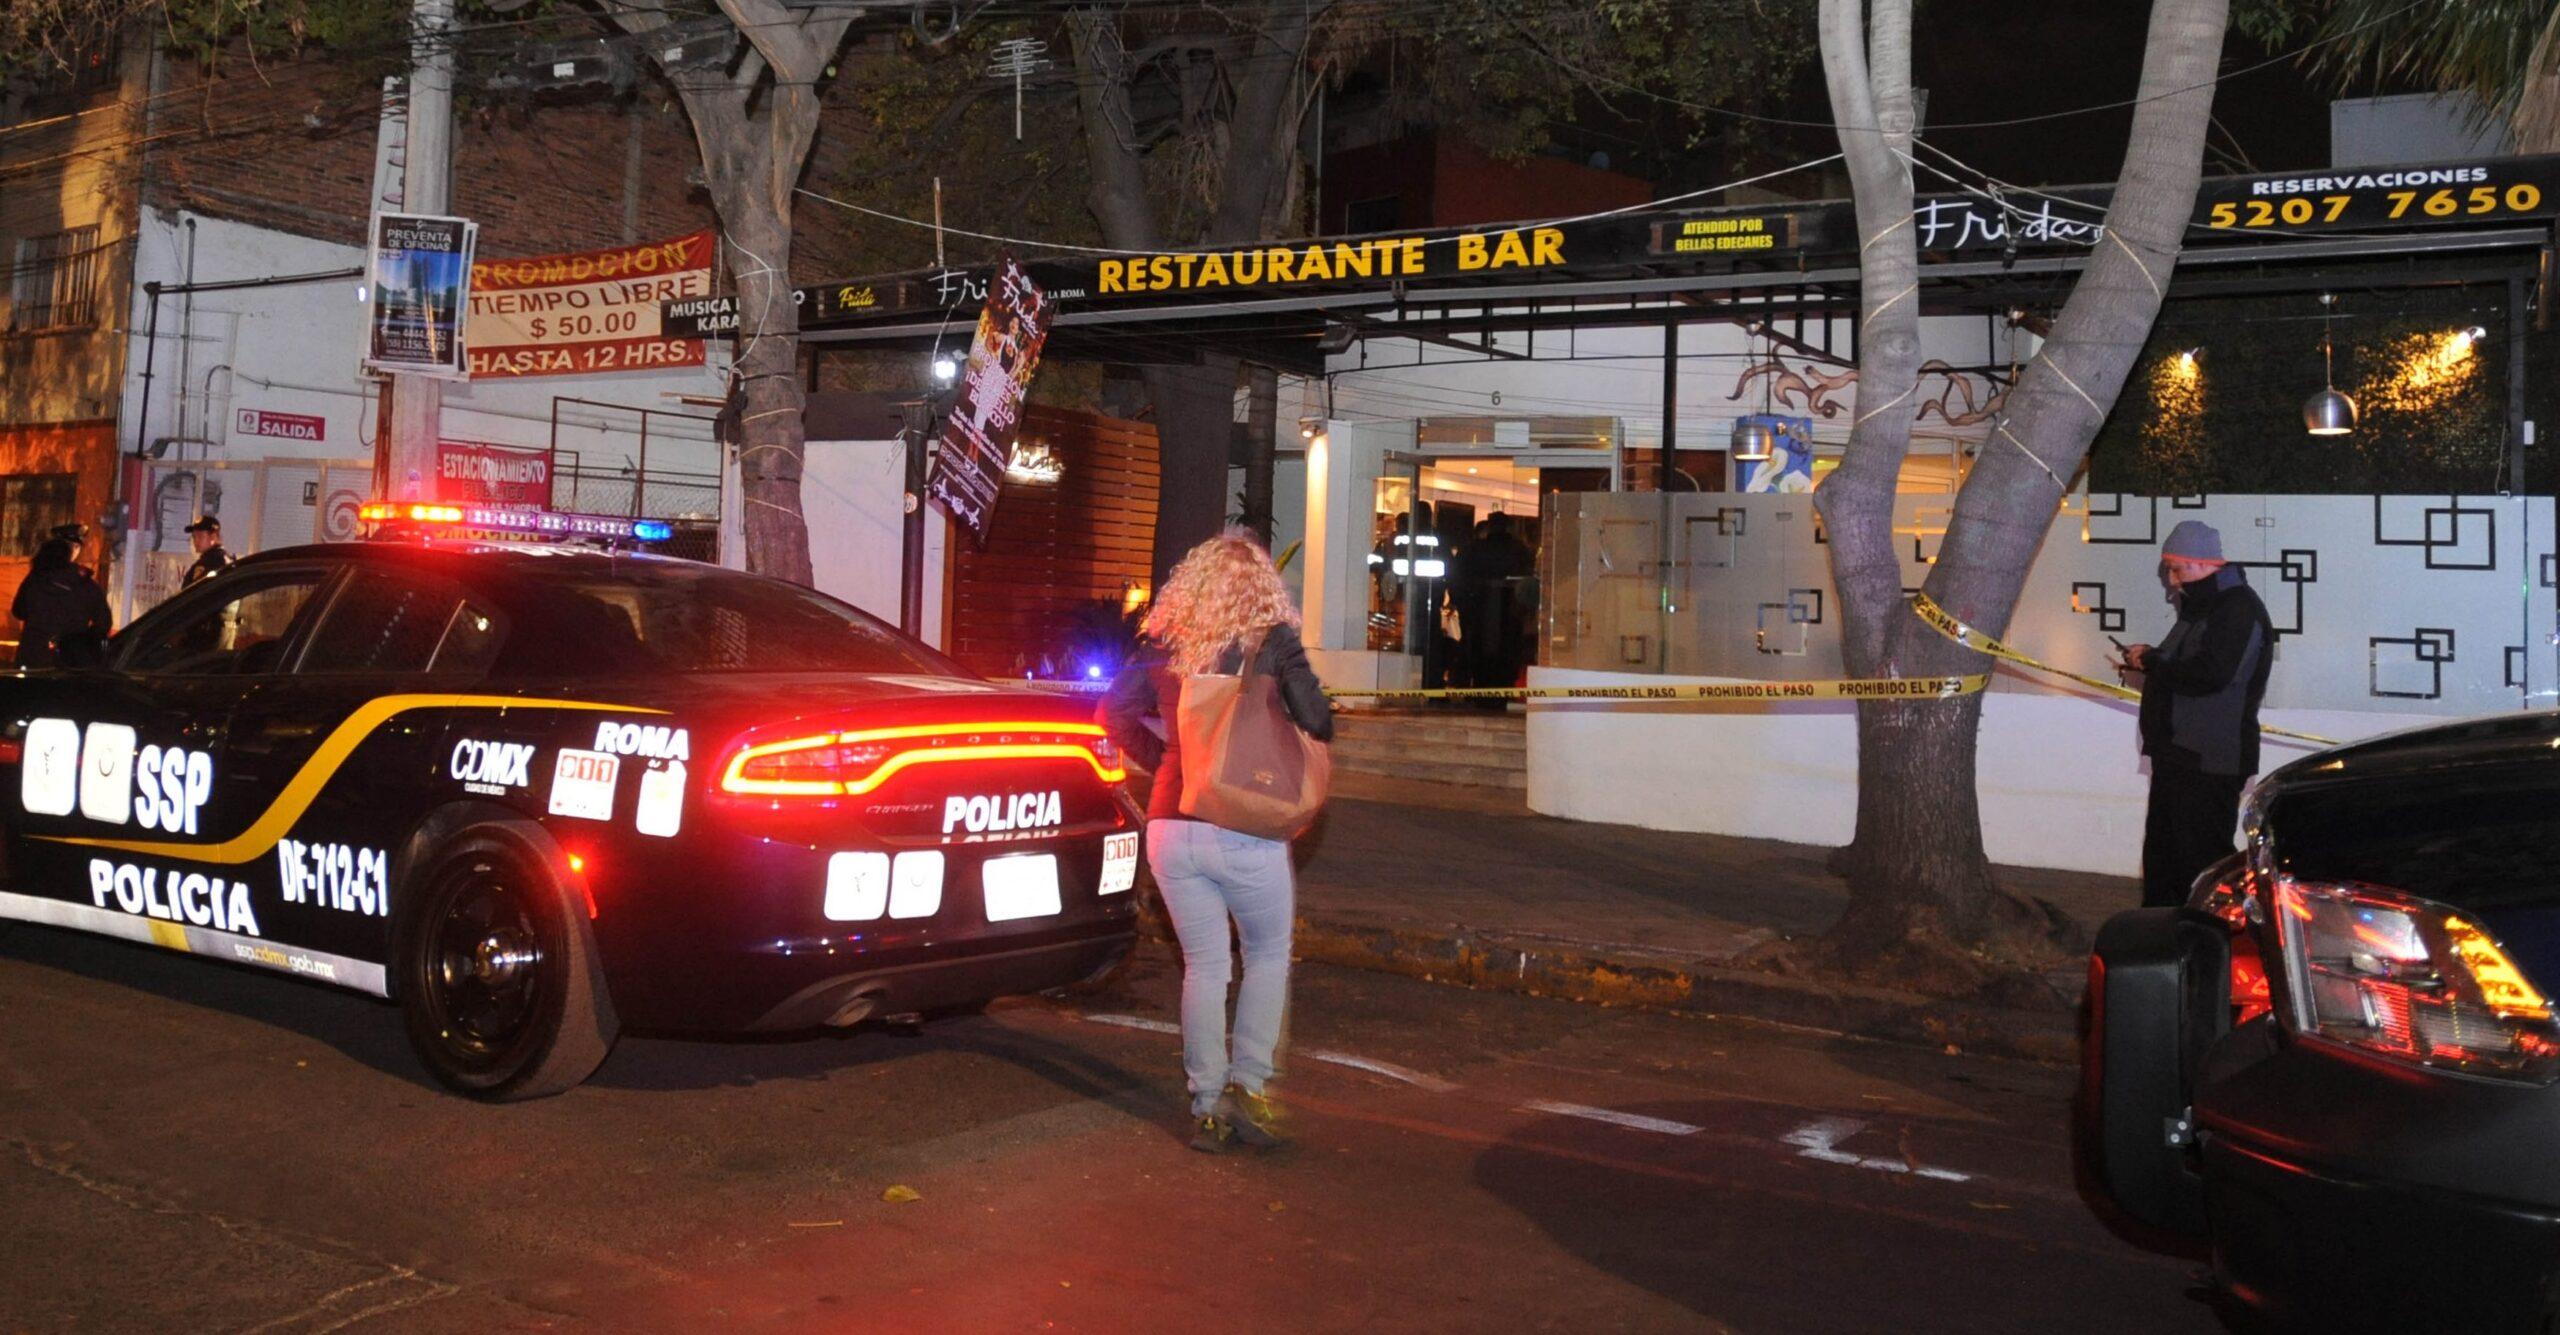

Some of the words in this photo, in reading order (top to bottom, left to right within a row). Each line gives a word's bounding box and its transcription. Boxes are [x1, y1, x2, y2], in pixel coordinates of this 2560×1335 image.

[2253, 167, 2488, 195] RESERVACIONES
[2210, 197, 2352, 229] 5207
[2387, 184, 2541, 219] 7650
[387, 228, 452, 242] PREVENTA
[1683, 220, 1737, 235] ATENDIDO
[1739, 219, 1763, 232] POR
[1913, 199, 2089, 248] Frida
[388, 239, 400, 248] DE
[404, 240, 450, 251] OFICINAS
[1676, 238, 1715, 251] BELLAS
[1717, 235, 1773, 249] EDECANES
[473, 240, 688, 288] PROMOCION
[1100, 237, 1425, 293] RESTAURANTE
[1458, 228, 1567, 271] BAR
[470, 290, 590, 315] TIEMPO
[600, 275, 699, 306] LIBRE
[928, 269, 988, 304] Fri
[1048, 291, 1058, 299] LA
[1060, 289, 1085, 298] ROMA
[670, 298, 732, 318] MUSICA
[530, 317, 547, 339] $
[559, 311, 637, 336] 50.00
[698, 315, 740, 332] KARA
[469, 349, 573, 373] HASTA
[583, 347, 614, 368] 12
[624, 340, 694, 365] HRS.
[1491, 390, 1501, 406] 6
[261, 421, 317, 439] SALIDA
[443, 453, 546, 484] ESTACIONAMIENTO
[1568, 688, 1628, 698] PROHIBIDO
[1631, 688, 1644, 698] EL
[1647, 687, 1676, 698] PASO
[1699, 686, 1763, 697] PROHIBIDO
[1766, 685, 1780, 696] EL
[1784, 683, 1814, 696] PASO
[1839, 682, 1907, 695] PROHIBIDO
[1911, 681, 1926, 694] EL
[1929, 680, 1962, 693] PAO
[594, 721, 690, 760] ROMA
[451, 739, 536, 786] CDMX
[560, 755, 614, 783] 911
[135, 745, 212, 835] SSP
[942, 791, 1061, 834] POLICIA
[1106, 836, 1136, 861] 11
[278, 838, 388, 917] DF-712-C1
[89, 858, 260, 936] POLICIA
[234, 943, 336, 979] ssp.cdmx.gob.mx
